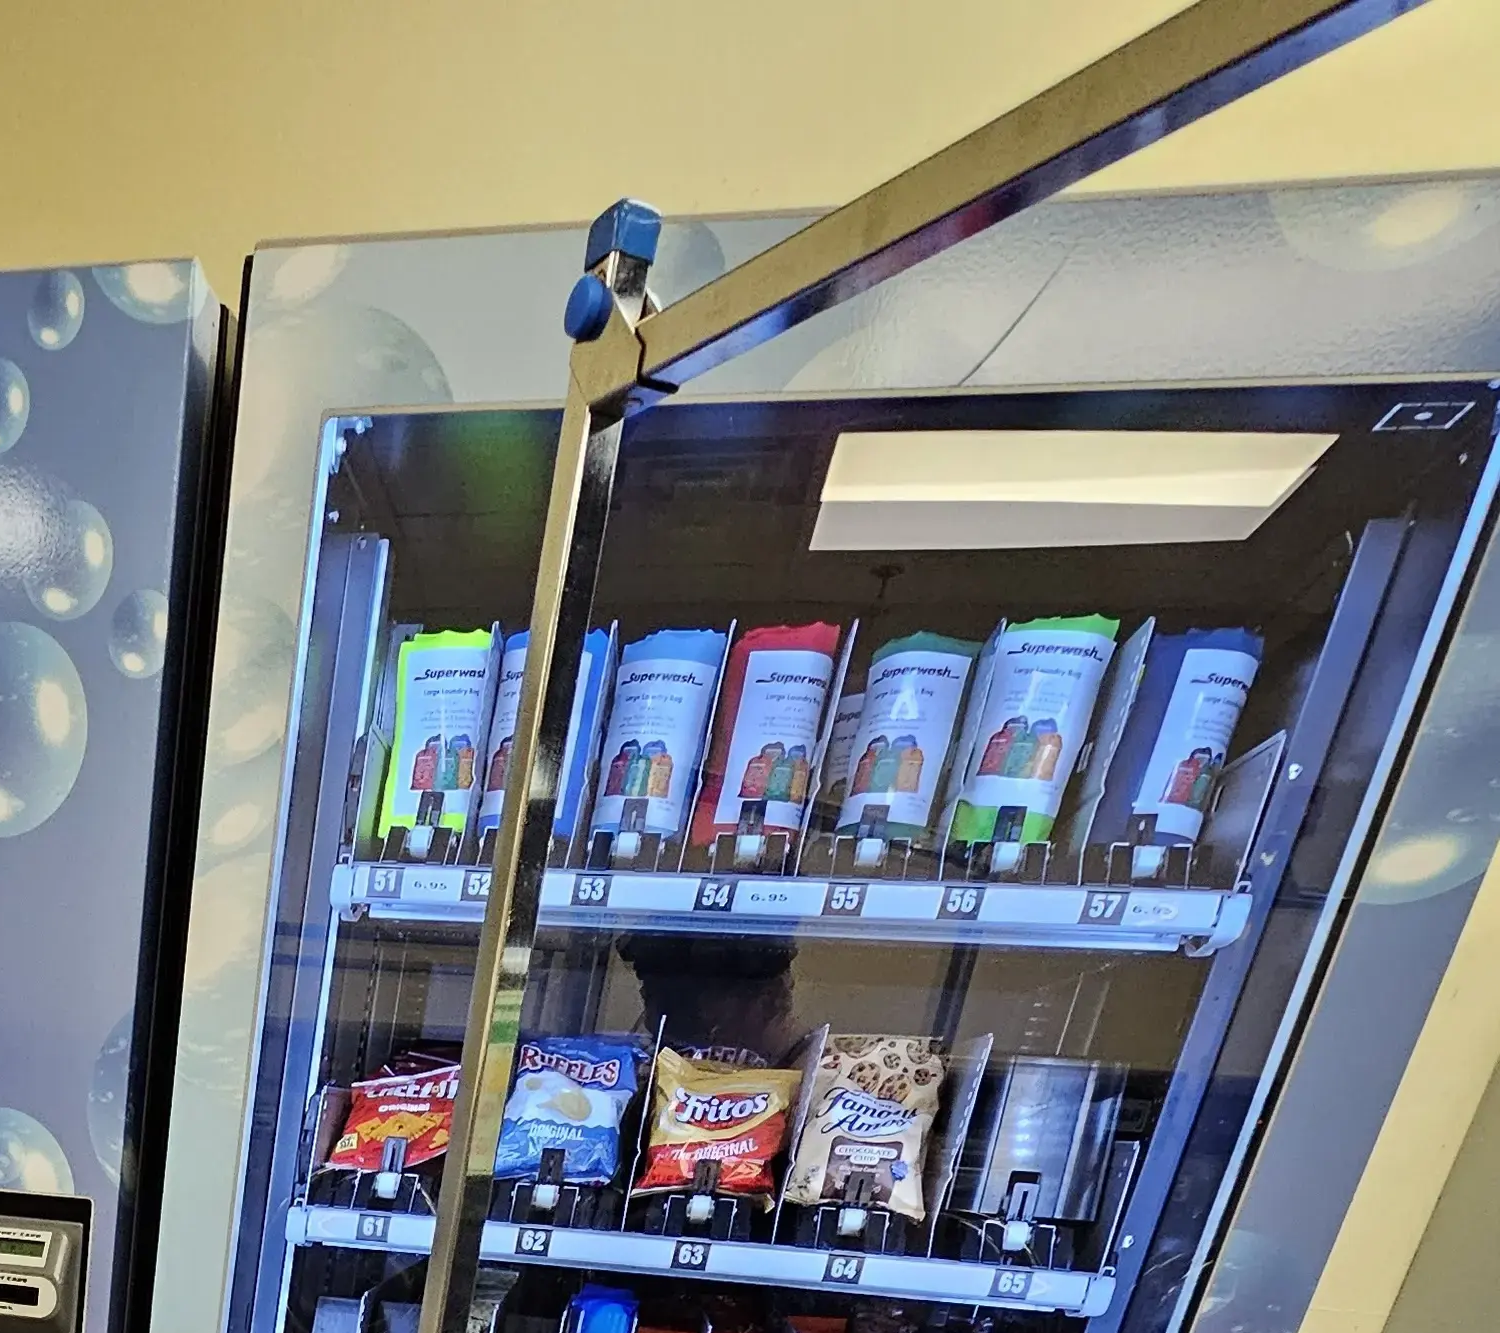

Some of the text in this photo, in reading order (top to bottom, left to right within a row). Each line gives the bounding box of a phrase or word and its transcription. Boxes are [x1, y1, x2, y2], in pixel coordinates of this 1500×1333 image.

[1007, 642, 1104, 662] Superwash
[621, 672, 703, 686] Superwash
[872, 665, 960, 686] Superwash
[373, 871, 491, 896] 51 6.95 52
[578, 878, 605, 900] 53
[701, 884, 729, 907] 54
[750, 893, 788, 902] 6.95
[831, 887, 860, 910] 55
[946, 889, 976, 913] 56
[1088, 895, 1122, 918] 57
[675, 1087, 770, 1123] Fritos
[815, 1086, 919, 1120] Famous
[528, 1122, 584, 1143] ORIGINAL
[362, 1218, 1027, 1294] 61 62 63 64 65
